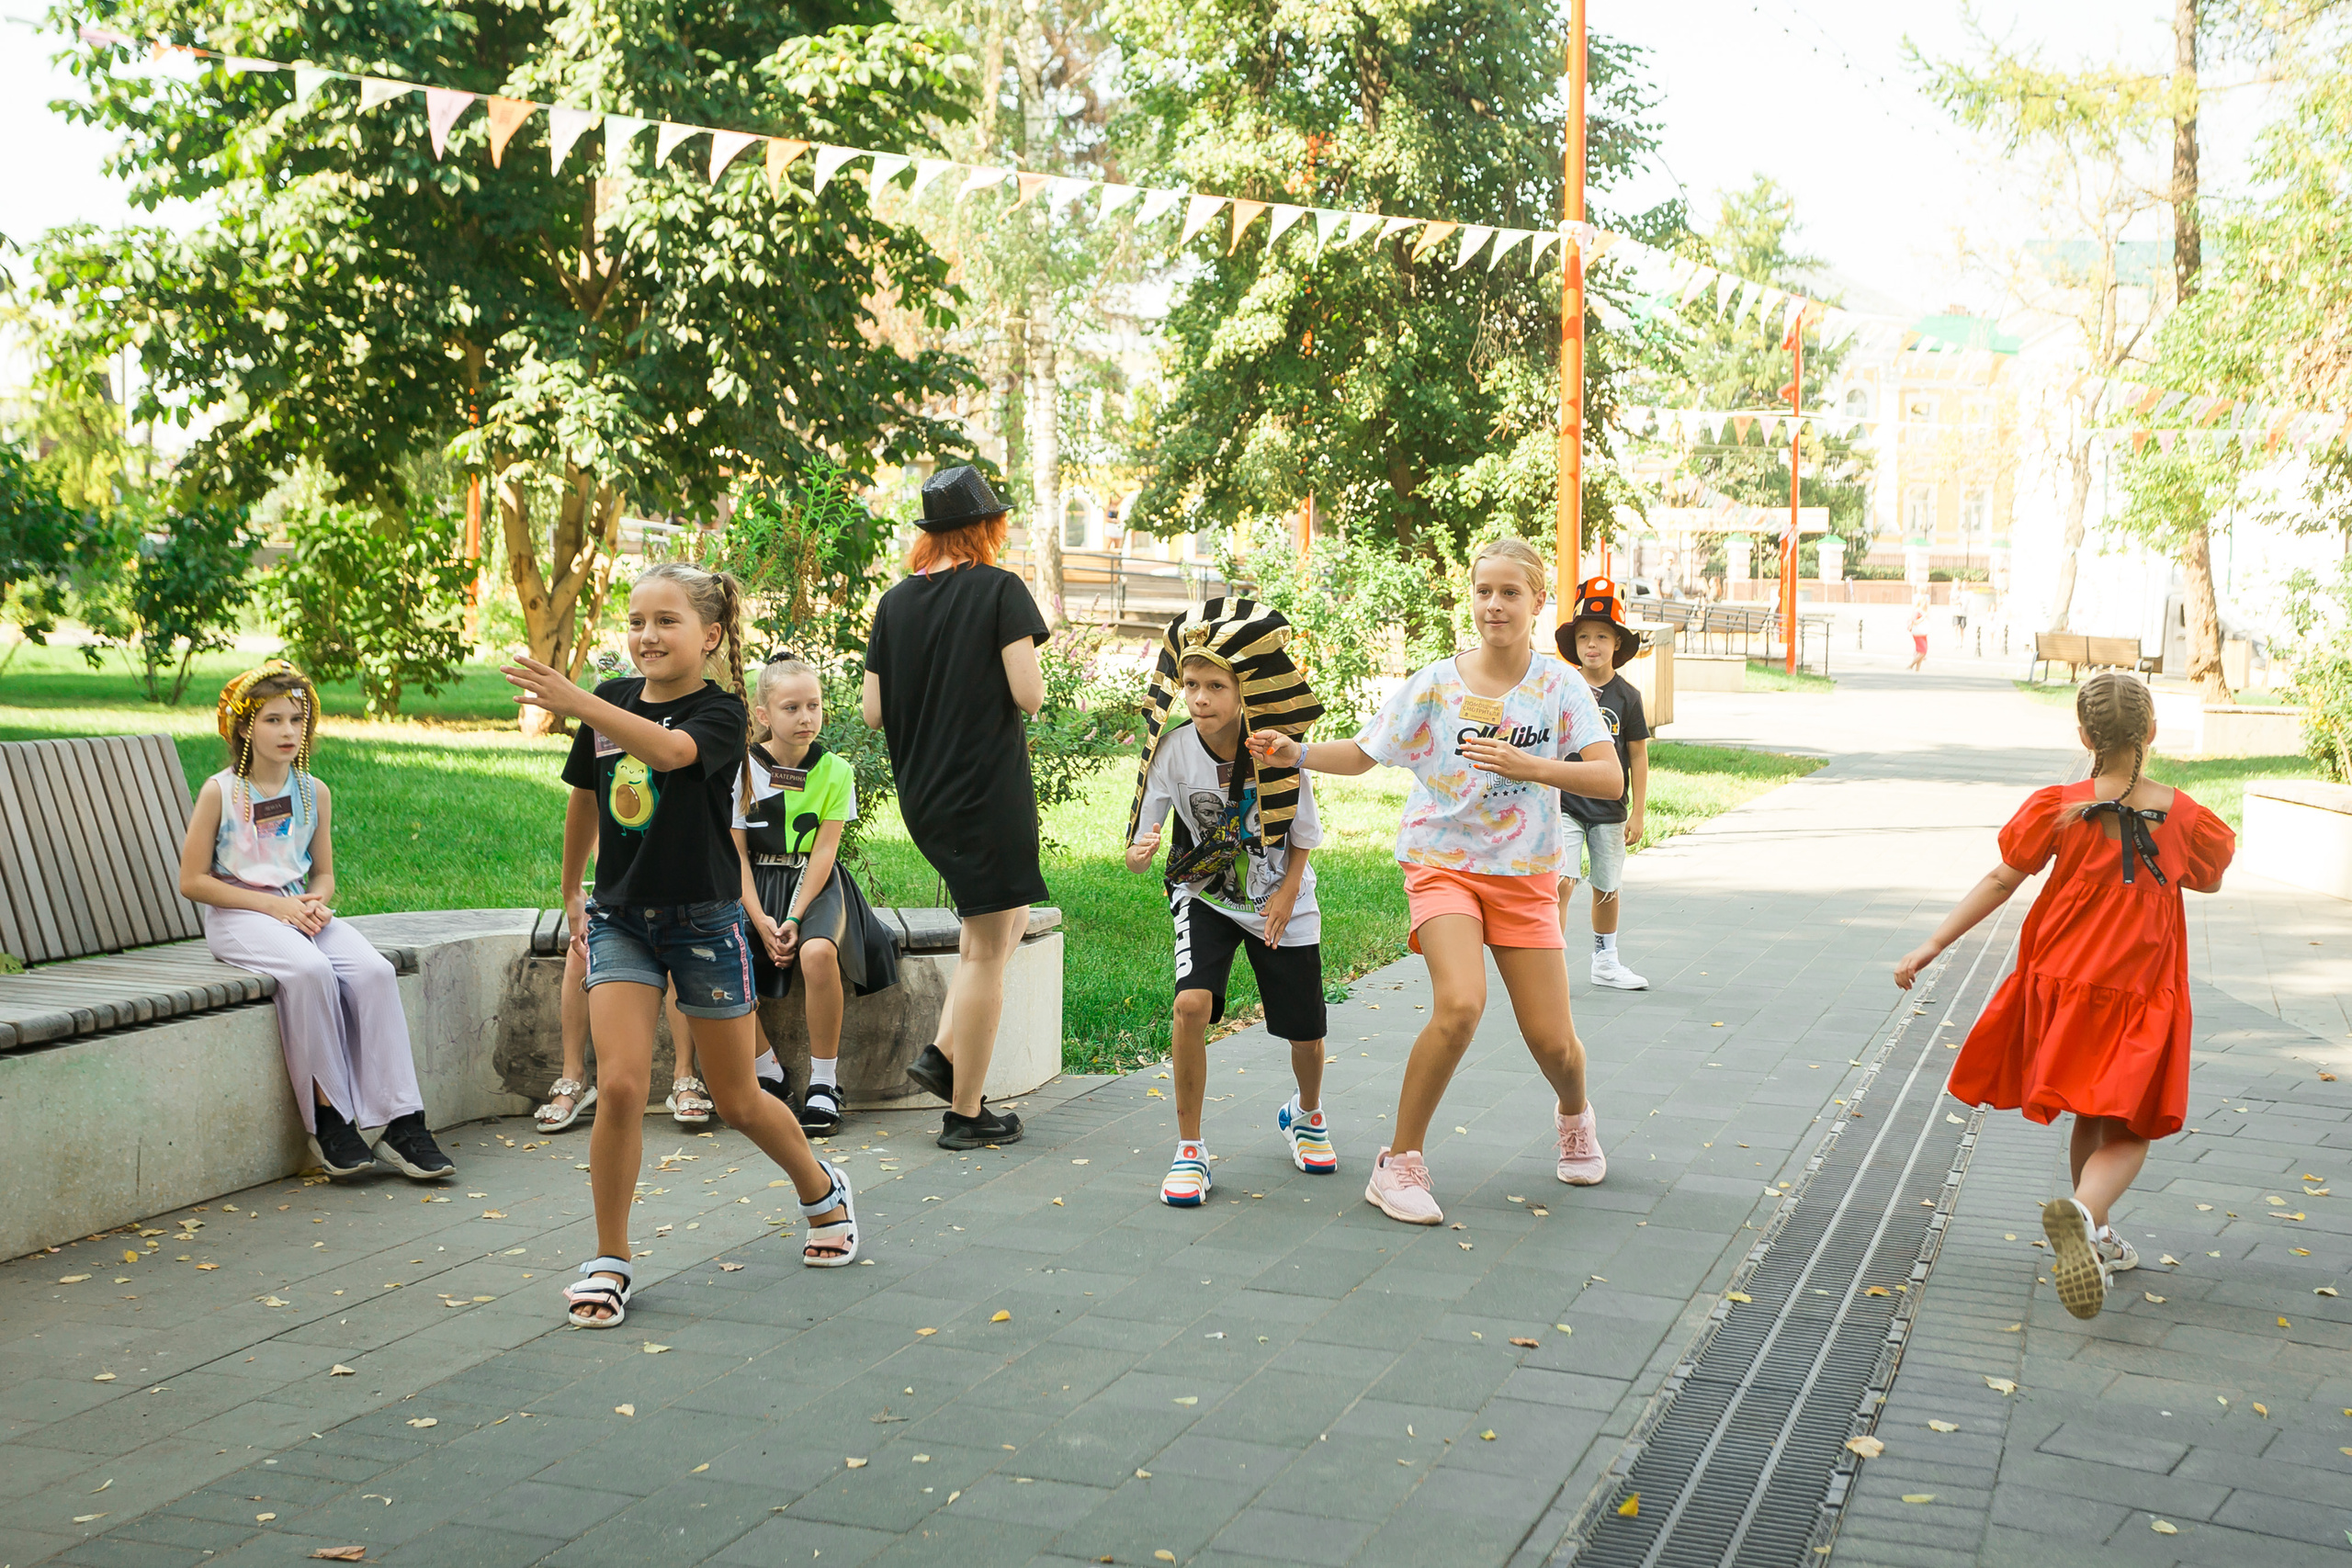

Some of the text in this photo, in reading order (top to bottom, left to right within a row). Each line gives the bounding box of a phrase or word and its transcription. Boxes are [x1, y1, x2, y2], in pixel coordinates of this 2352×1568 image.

[1463, 706, 1499, 716] СМОТРИТЕЛЯ
[1465, 701, 1499, 711] ПОМОЩНИК
[772, 773, 806, 782] ЕКАТЕРИНА
